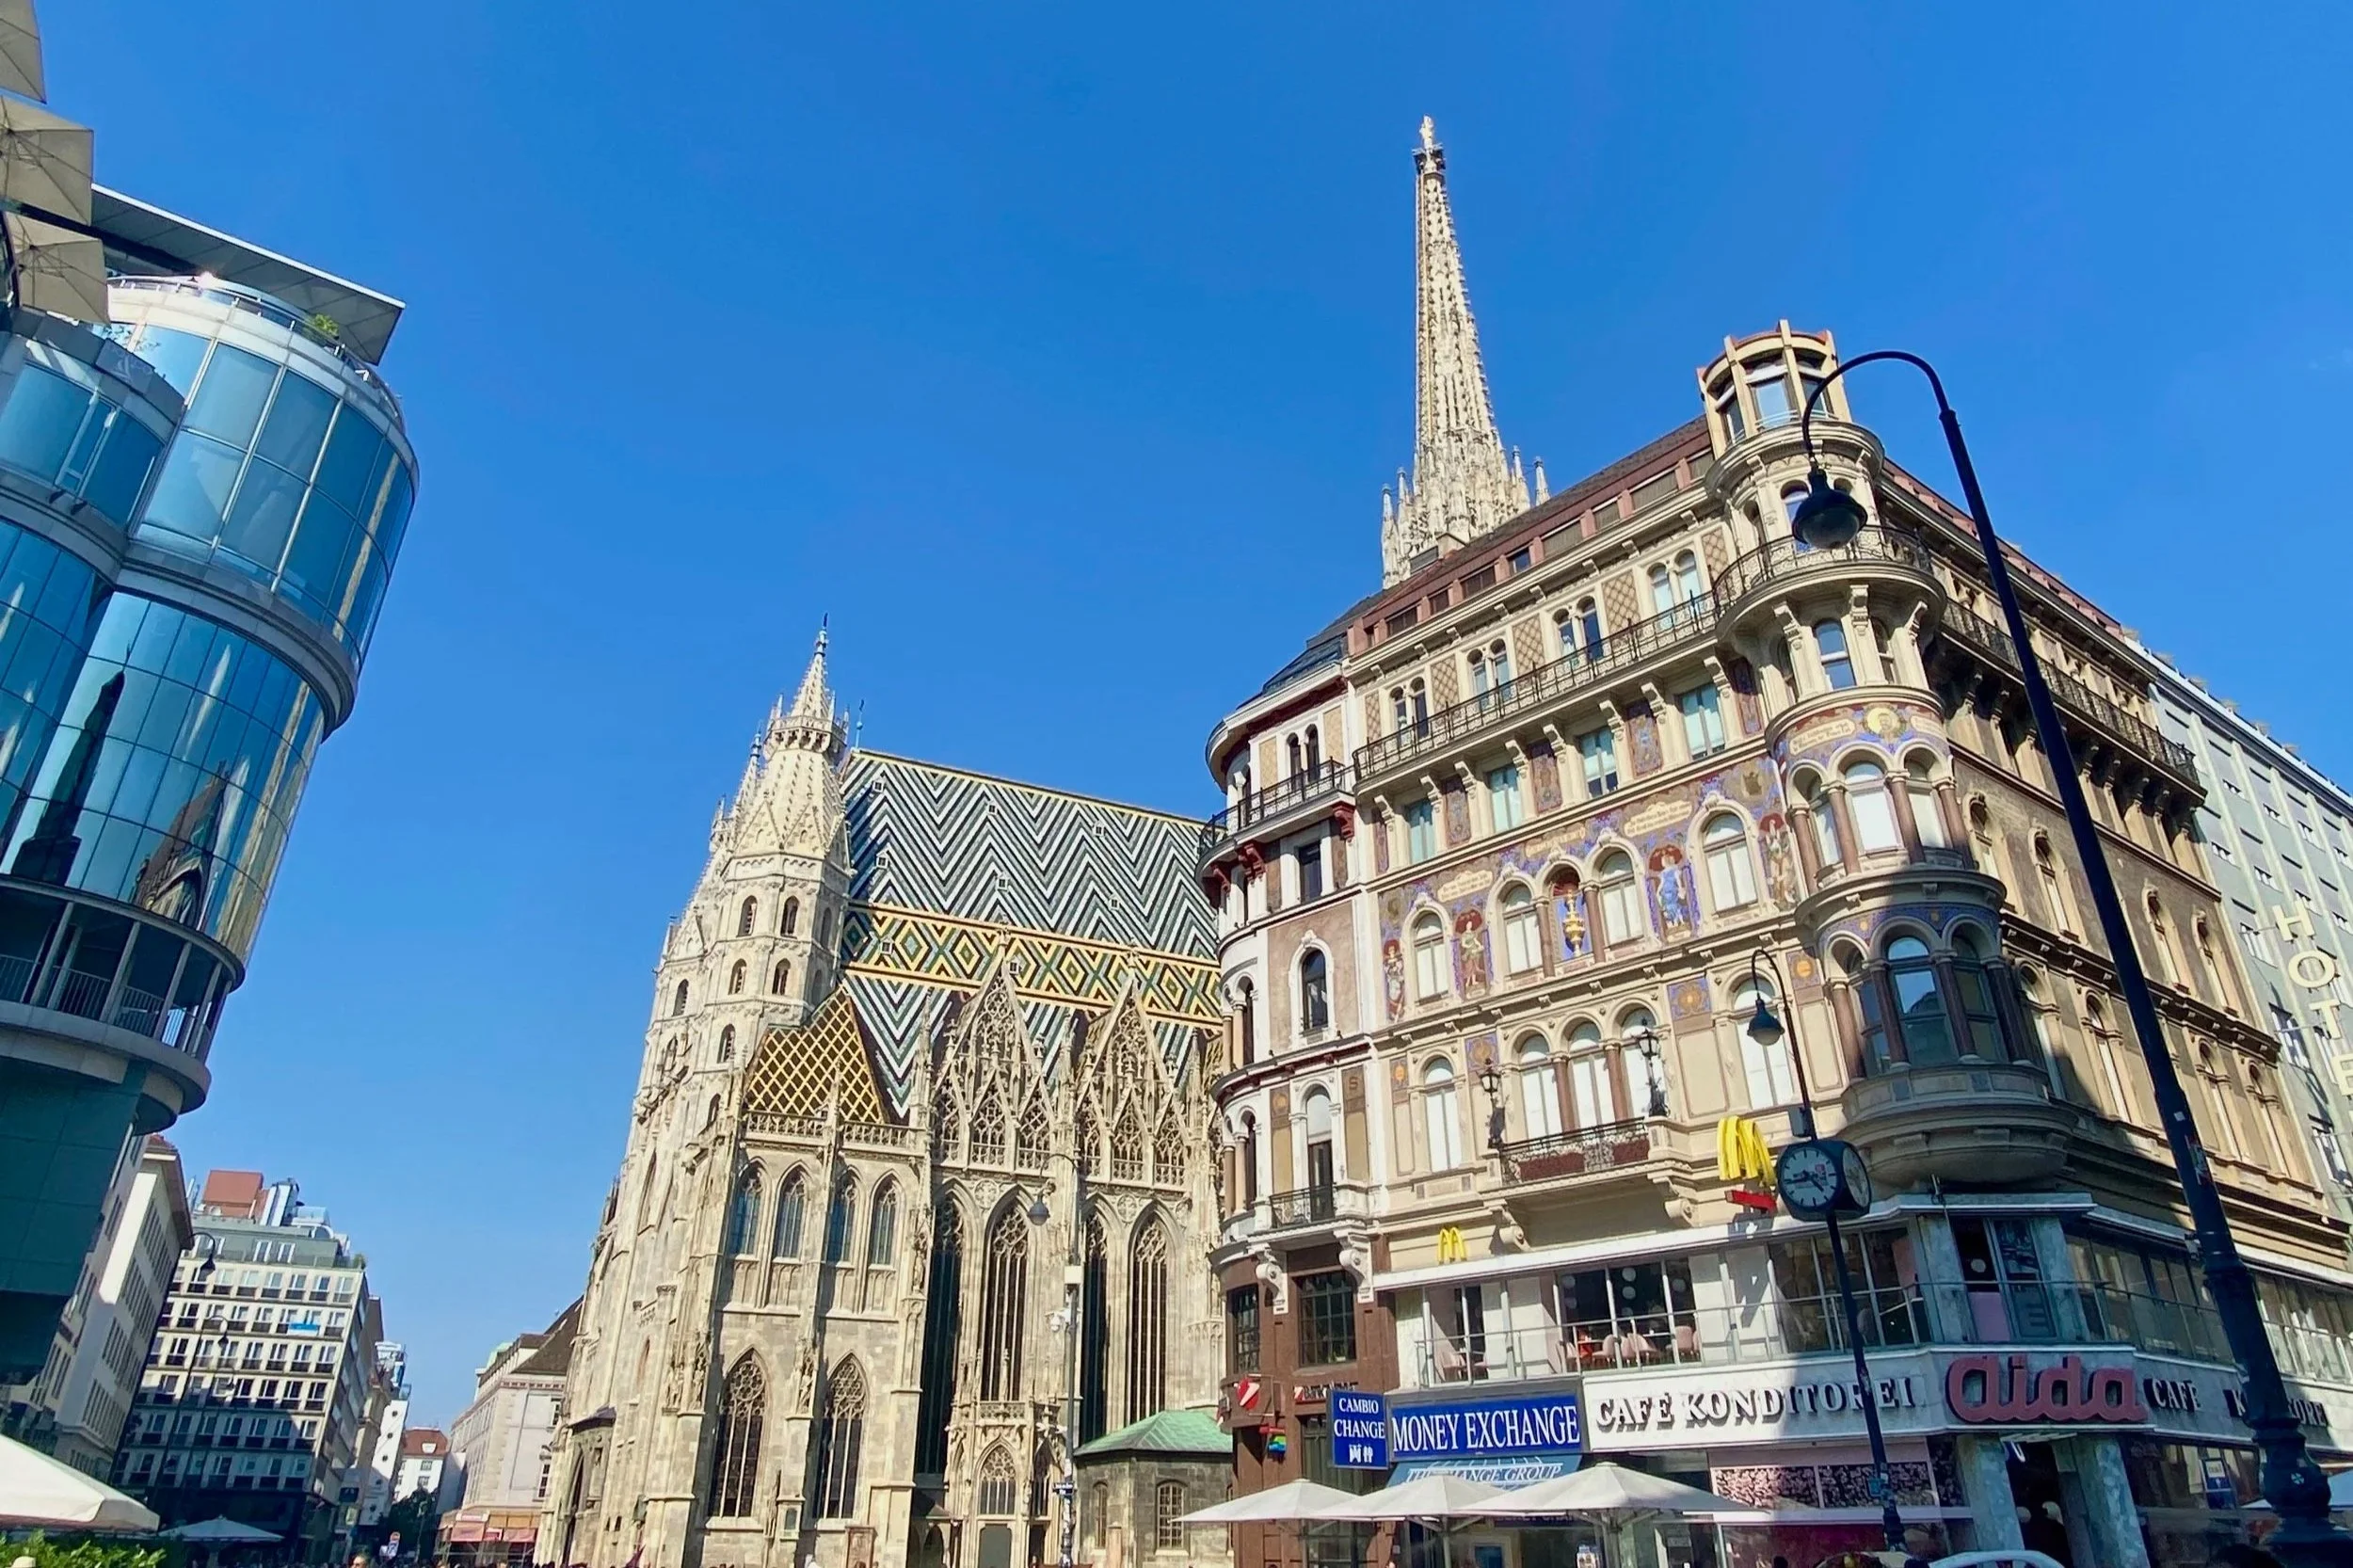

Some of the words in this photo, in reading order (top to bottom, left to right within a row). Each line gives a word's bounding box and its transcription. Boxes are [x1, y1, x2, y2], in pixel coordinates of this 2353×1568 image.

[2271, 899, 2353, 1096] HOTE
[1338, 1398, 1379, 1414] CAMBIO
[1596, 1392, 1674, 1428] CAFE
[1685, 1377, 1917, 1427] KONDITOREI
[2149, 1378, 2202, 1412] CAFE
[1334, 1418, 1386, 1440] CHANGE
[1392, 1413, 1460, 1452] MONEY
[1464, 1405, 1580, 1449] EXCHANGE
[1504, 1464, 1562, 1481] GROUP
